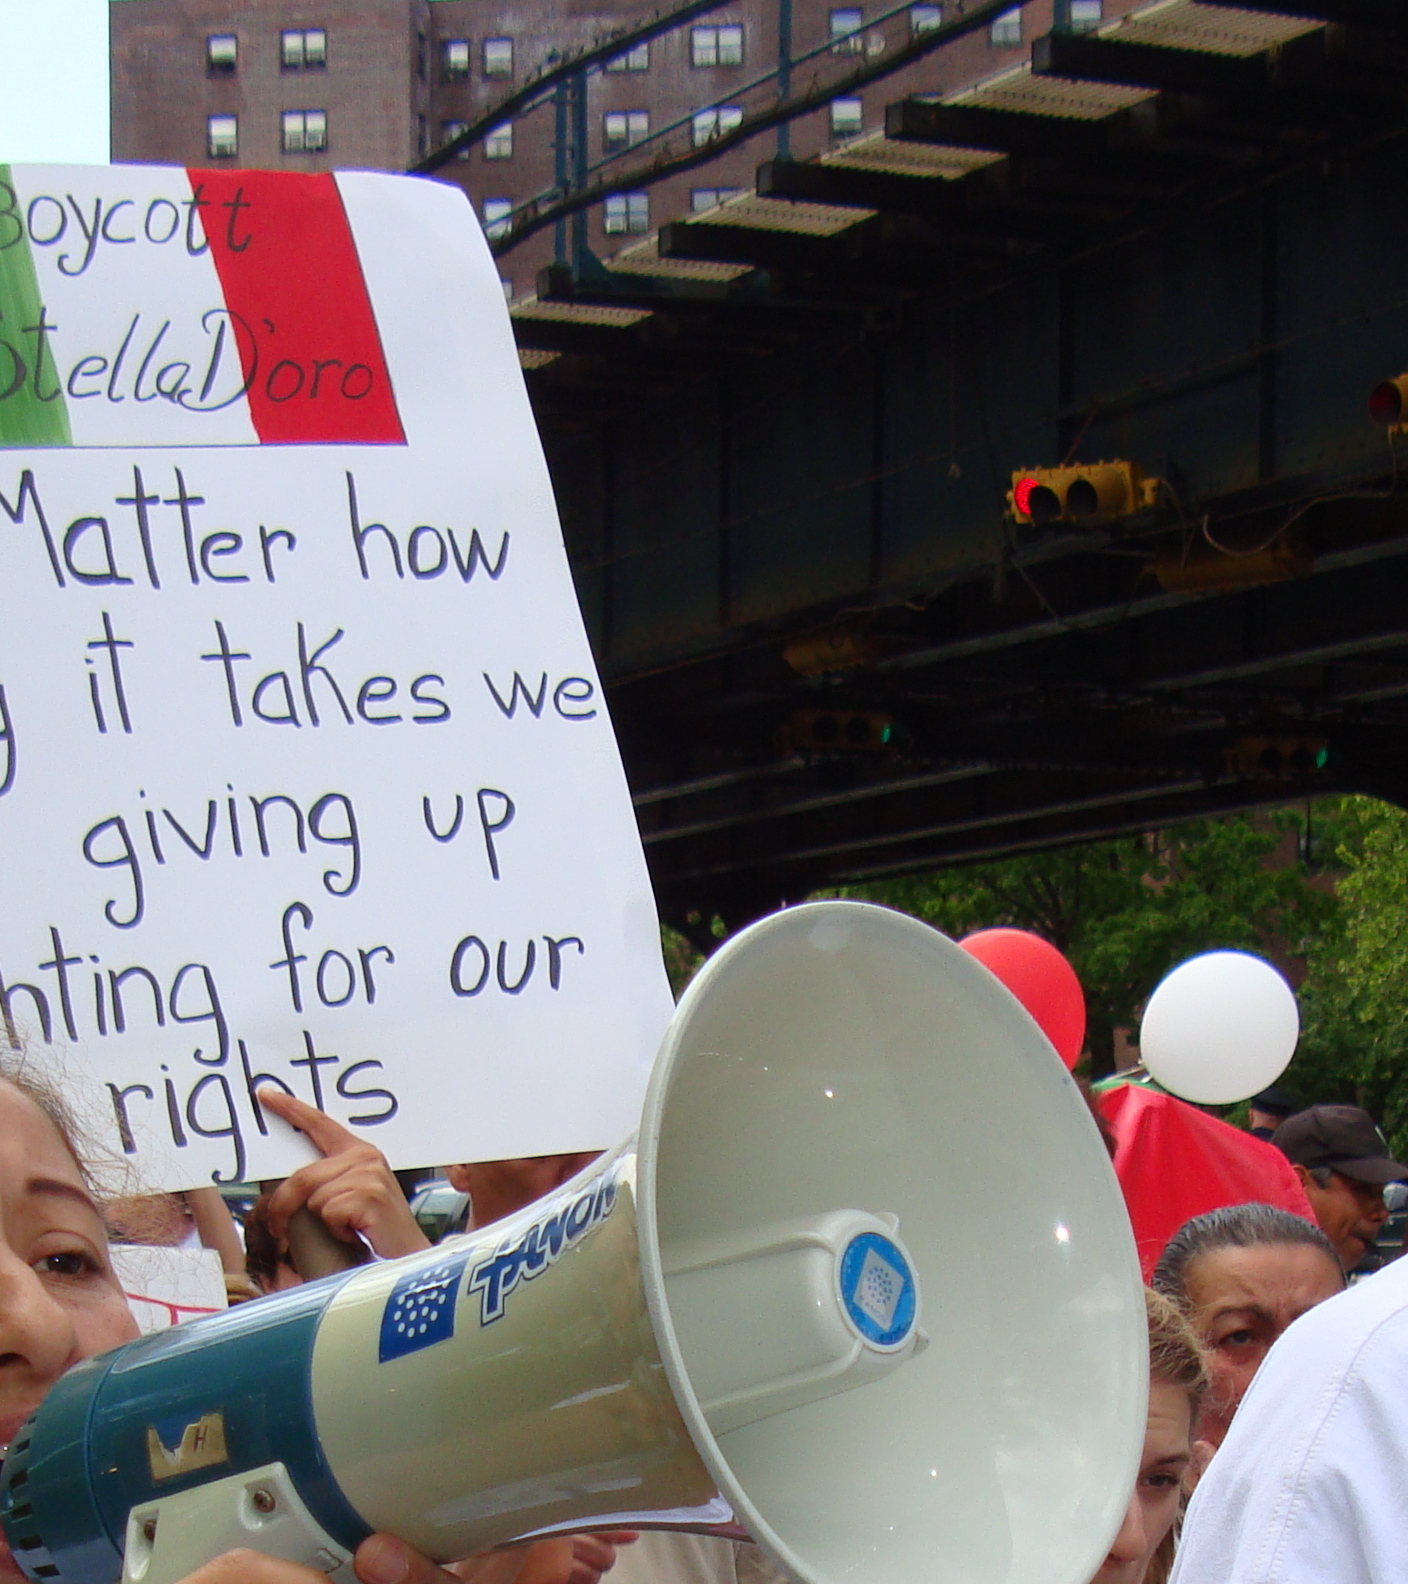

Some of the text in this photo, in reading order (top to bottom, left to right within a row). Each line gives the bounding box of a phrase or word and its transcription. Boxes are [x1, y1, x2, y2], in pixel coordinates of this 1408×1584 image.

[346, 470, 512, 584] how
[84, 611, 135, 737] it
[200, 618, 454, 730] takes
[484, 666, 599, 722] we
[81, 783, 362, 930] giving
[421, 787, 516, 881] up
[269, 900, 396, 1015] for
[448, 931, 585, 998] our
[105, 1029, 401, 1185] rights
